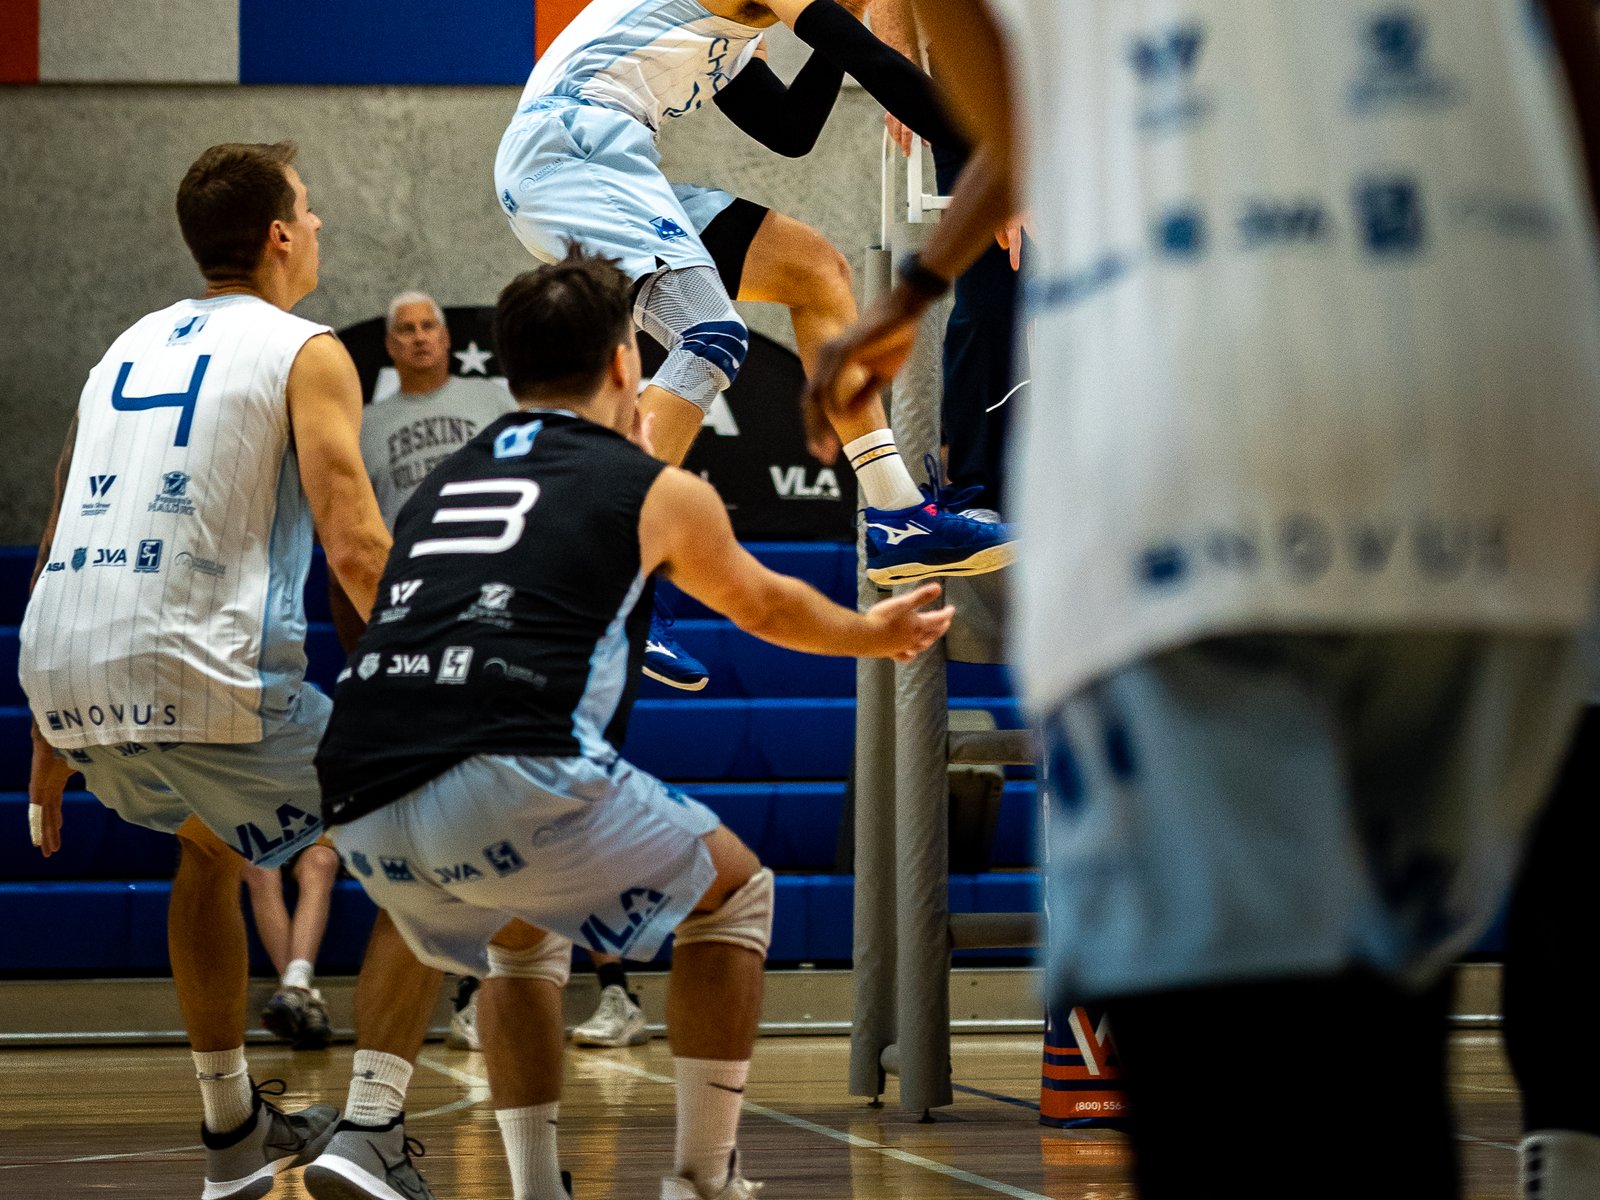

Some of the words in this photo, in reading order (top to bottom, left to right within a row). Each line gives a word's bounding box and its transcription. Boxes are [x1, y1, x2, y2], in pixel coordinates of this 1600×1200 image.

[111, 354, 211, 447] 4
[769, 465, 841, 498] VLA
[408, 477, 540, 558] 3
[92, 549, 127, 564] JVA
[386, 654, 431, 674] JVA
[62, 704, 177, 729] NOVUS
[434, 862, 483, 885] JVA
[1075, 1102, 1101, 1112] (800)
